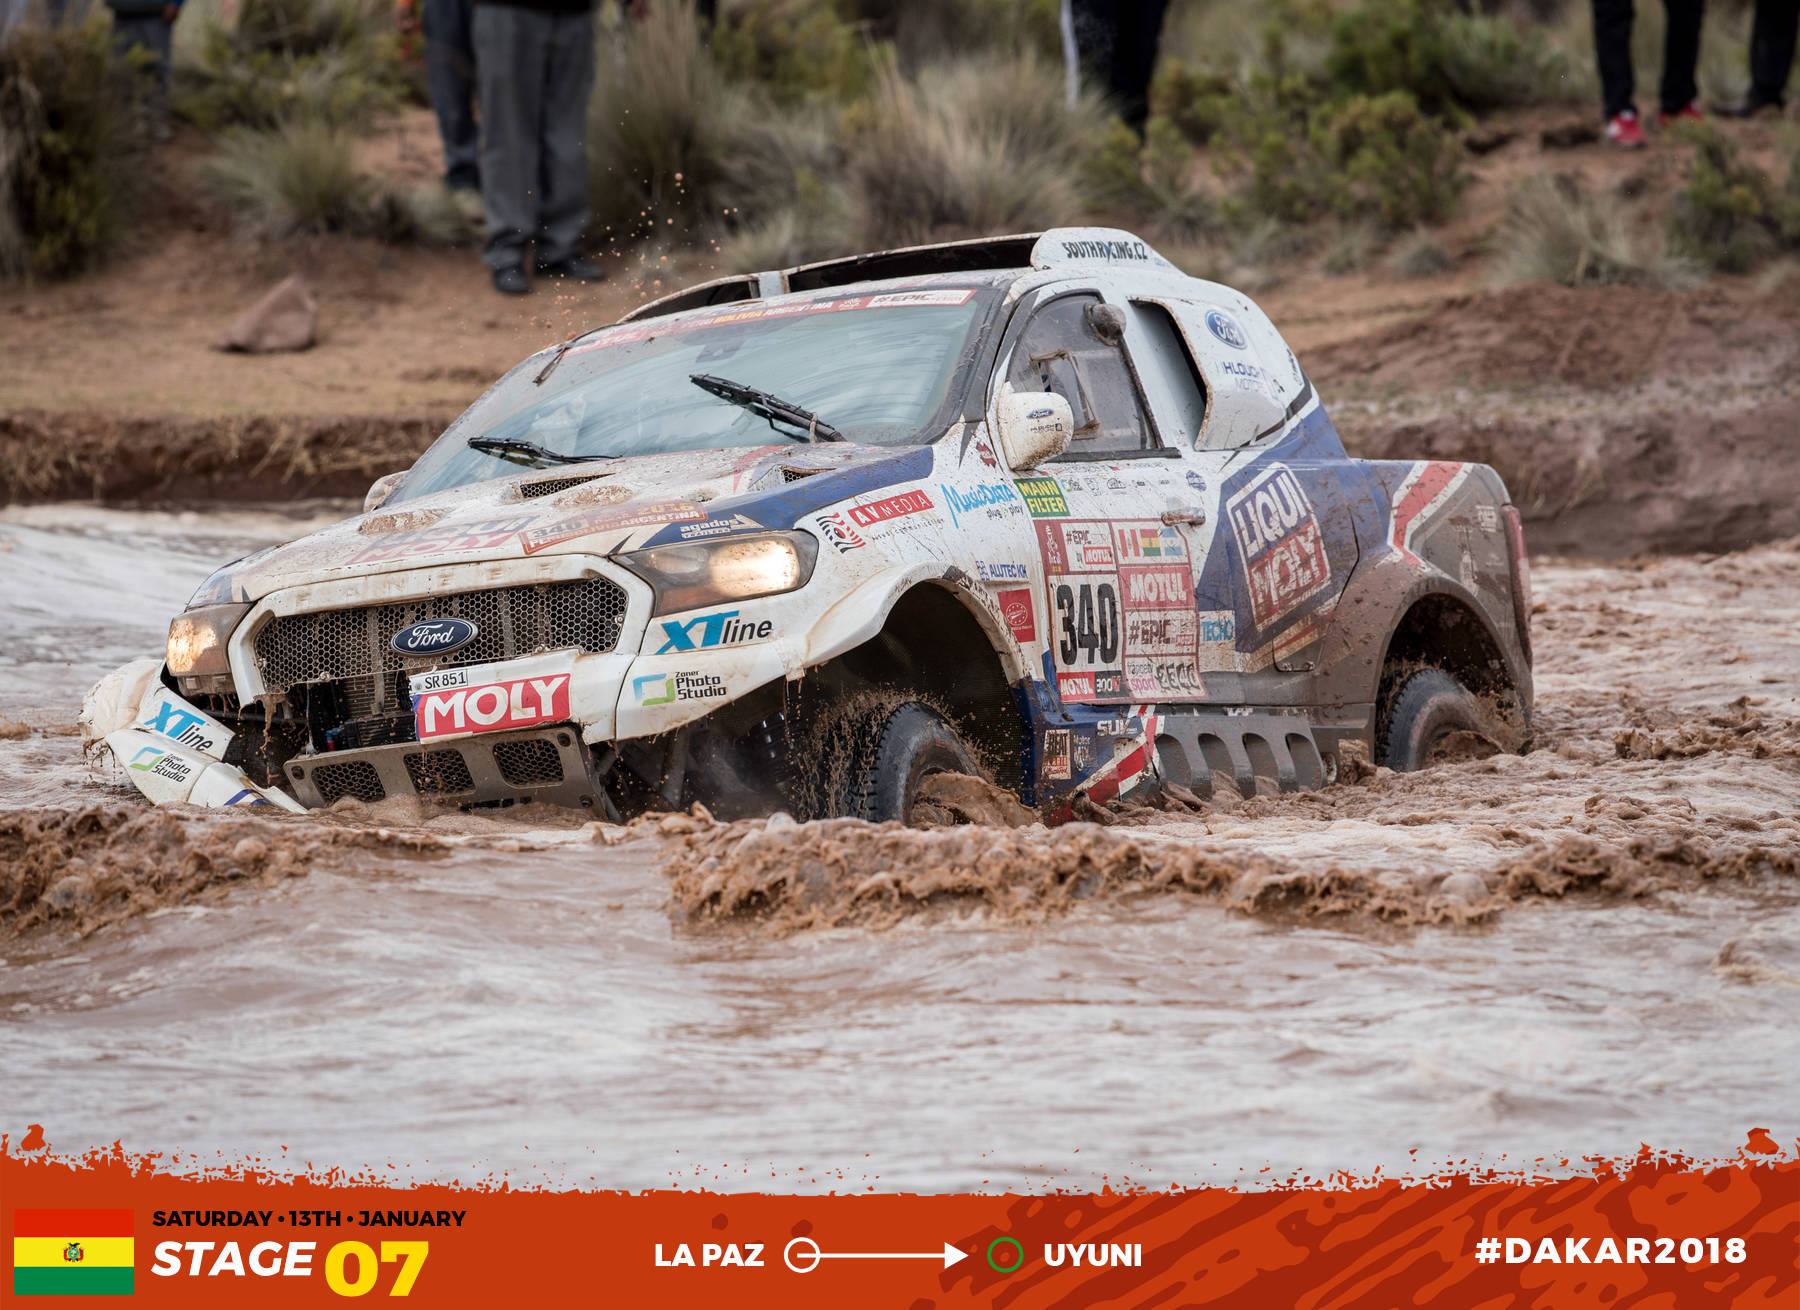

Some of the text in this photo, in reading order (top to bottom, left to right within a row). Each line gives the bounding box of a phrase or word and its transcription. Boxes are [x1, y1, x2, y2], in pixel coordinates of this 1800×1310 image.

[1020, 481, 1059, 497] MANN
[1028, 498, 1066, 513] FILTER
[1235, 472, 1307, 559] LIQUI
[1252, 525, 1321, 606] MOLY
[1130, 573, 1187, 602] MOTUL
[655, 610, 773, 655] XTline
[1056, 584, 1118, 665] 340
[1129, 619, 1171, 645] #EPIC
[408, 624, 455, 648] Ford
[675, 670, 700, 678] Zoner
[676, 674, 721, 689] Photo
[678, 686, 728, 700] Studio
[1061, 678, 1093, 697] MOTUL
[423, 677, 562, 734] MOLY
[143, 701, 214, 753] XTline
[160, 757, 191, 775] Photo
[167, 753, 184, 763] Zoner
[151, 764, 187, 783] Studio
